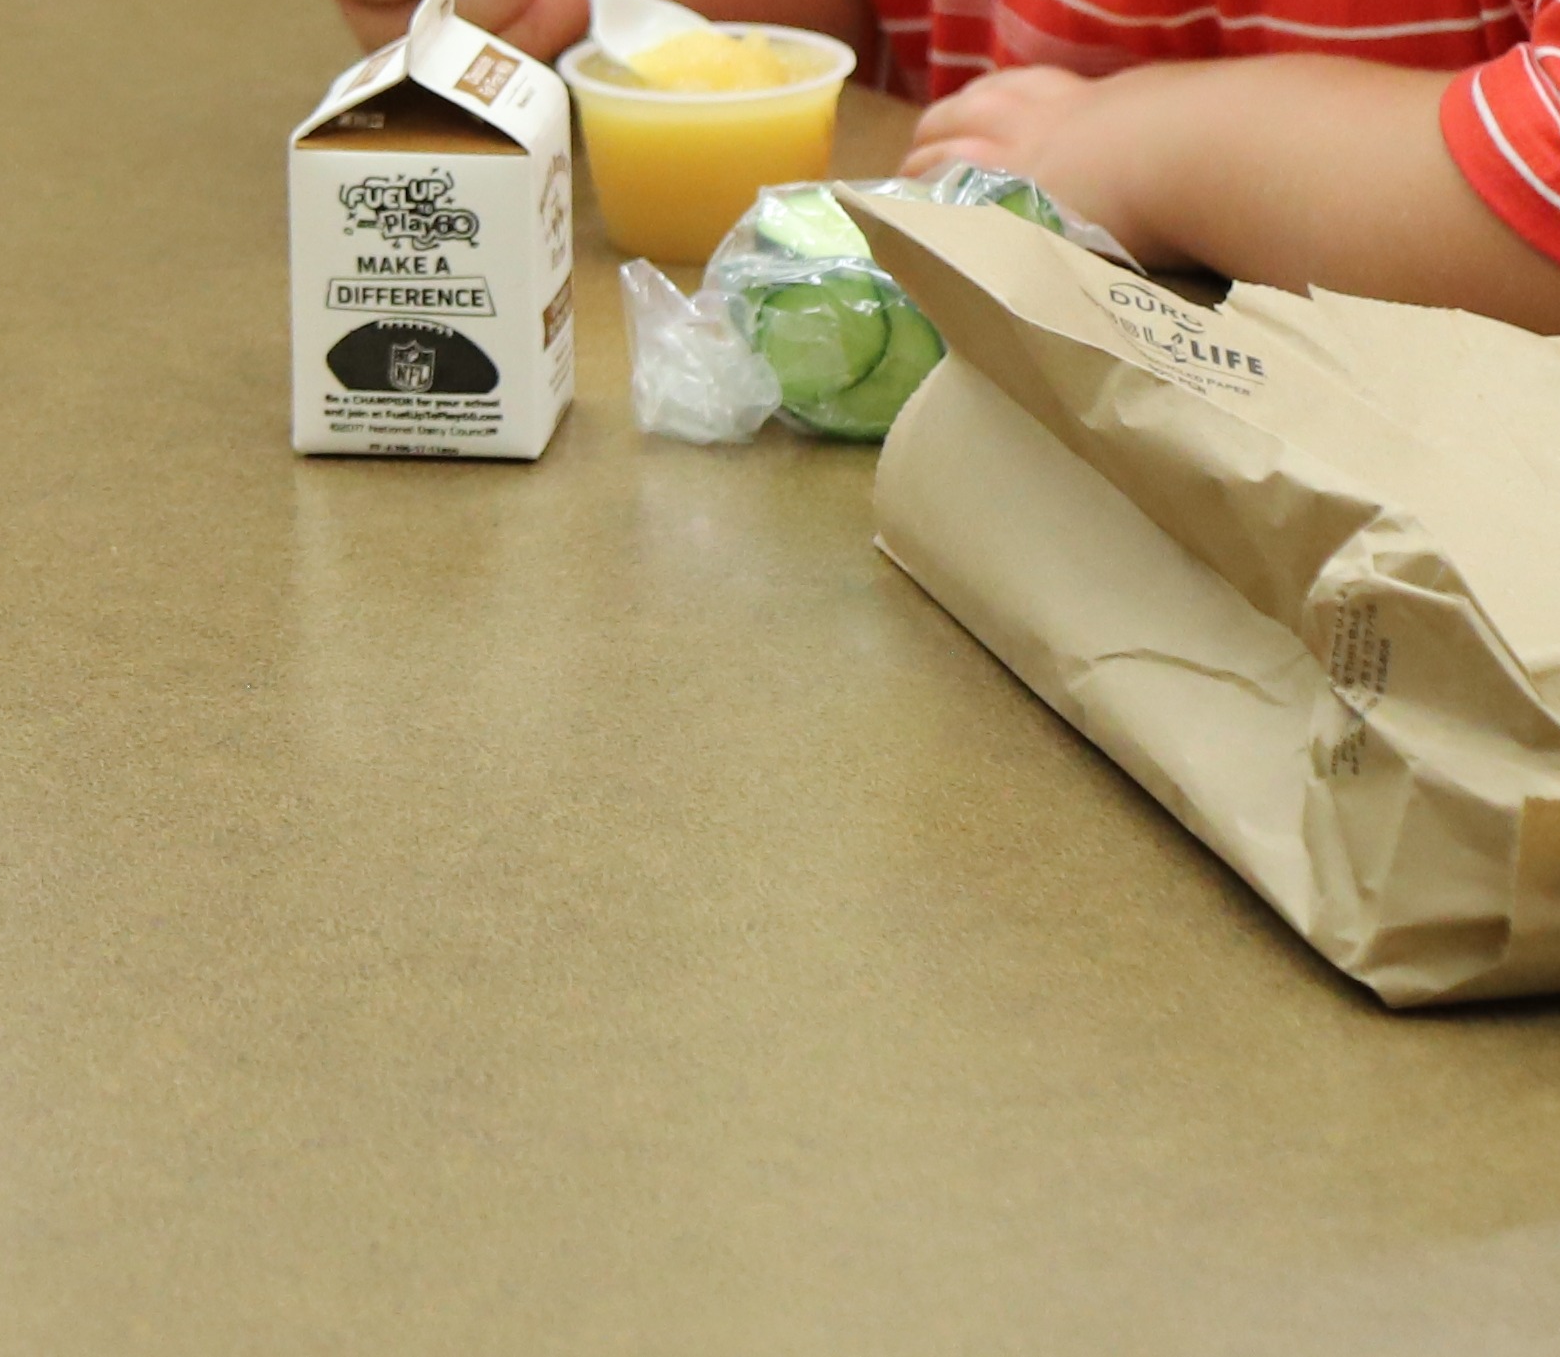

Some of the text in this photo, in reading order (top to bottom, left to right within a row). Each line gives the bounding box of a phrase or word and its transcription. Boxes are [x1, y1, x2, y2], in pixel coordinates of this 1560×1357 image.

[346, 179, 448, 210] FUEL UP
[357, 256, 451, 275] MAKE A
[337, 286, 485, 307] DIFFERENCE
[1190, 340, 1264, 376] LIFE
[396, 364, 429, 386] NFL
